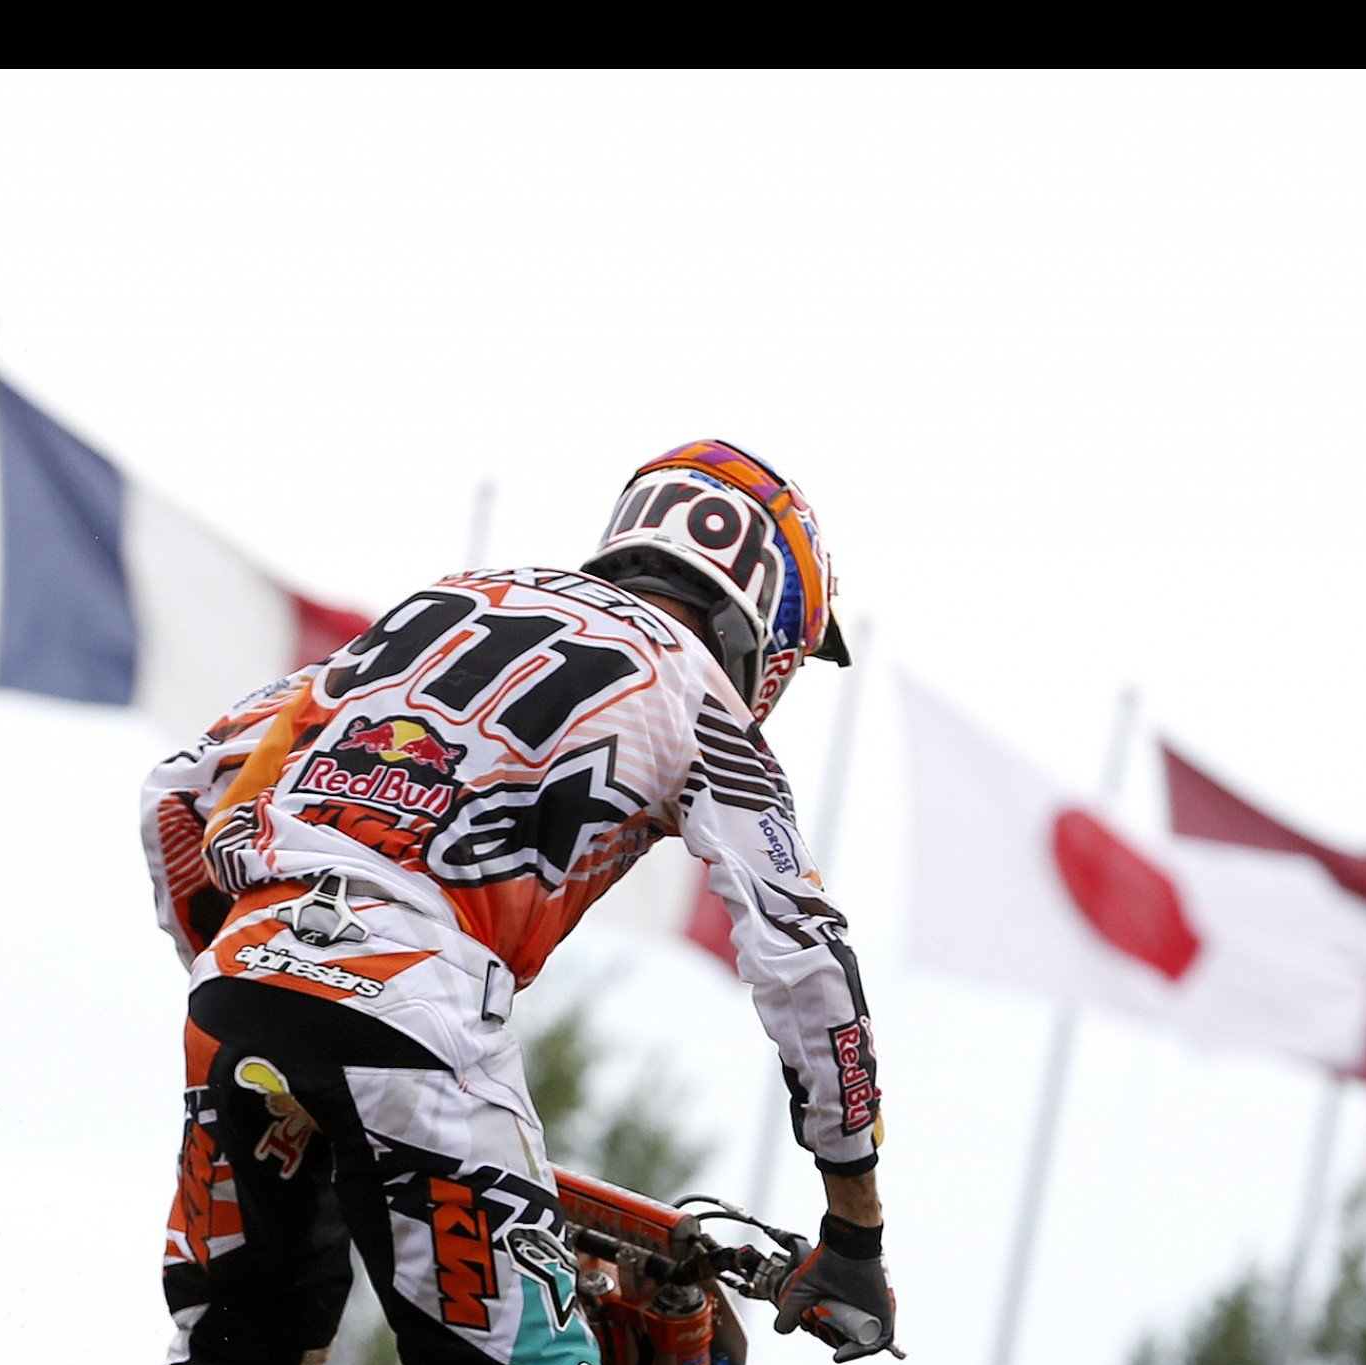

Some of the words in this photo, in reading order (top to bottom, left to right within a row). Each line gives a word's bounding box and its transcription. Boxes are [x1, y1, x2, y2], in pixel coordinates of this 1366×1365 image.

[613, 482, 778, 614] iroh
[325, 590, 643, 751] 911
[758, 818, 796, 872] BORGESE
[766, 849, 786, 874] AUTO
[234, 944, 385, 998] alpinestars
[428, 1174, 500, 1332] KTM
